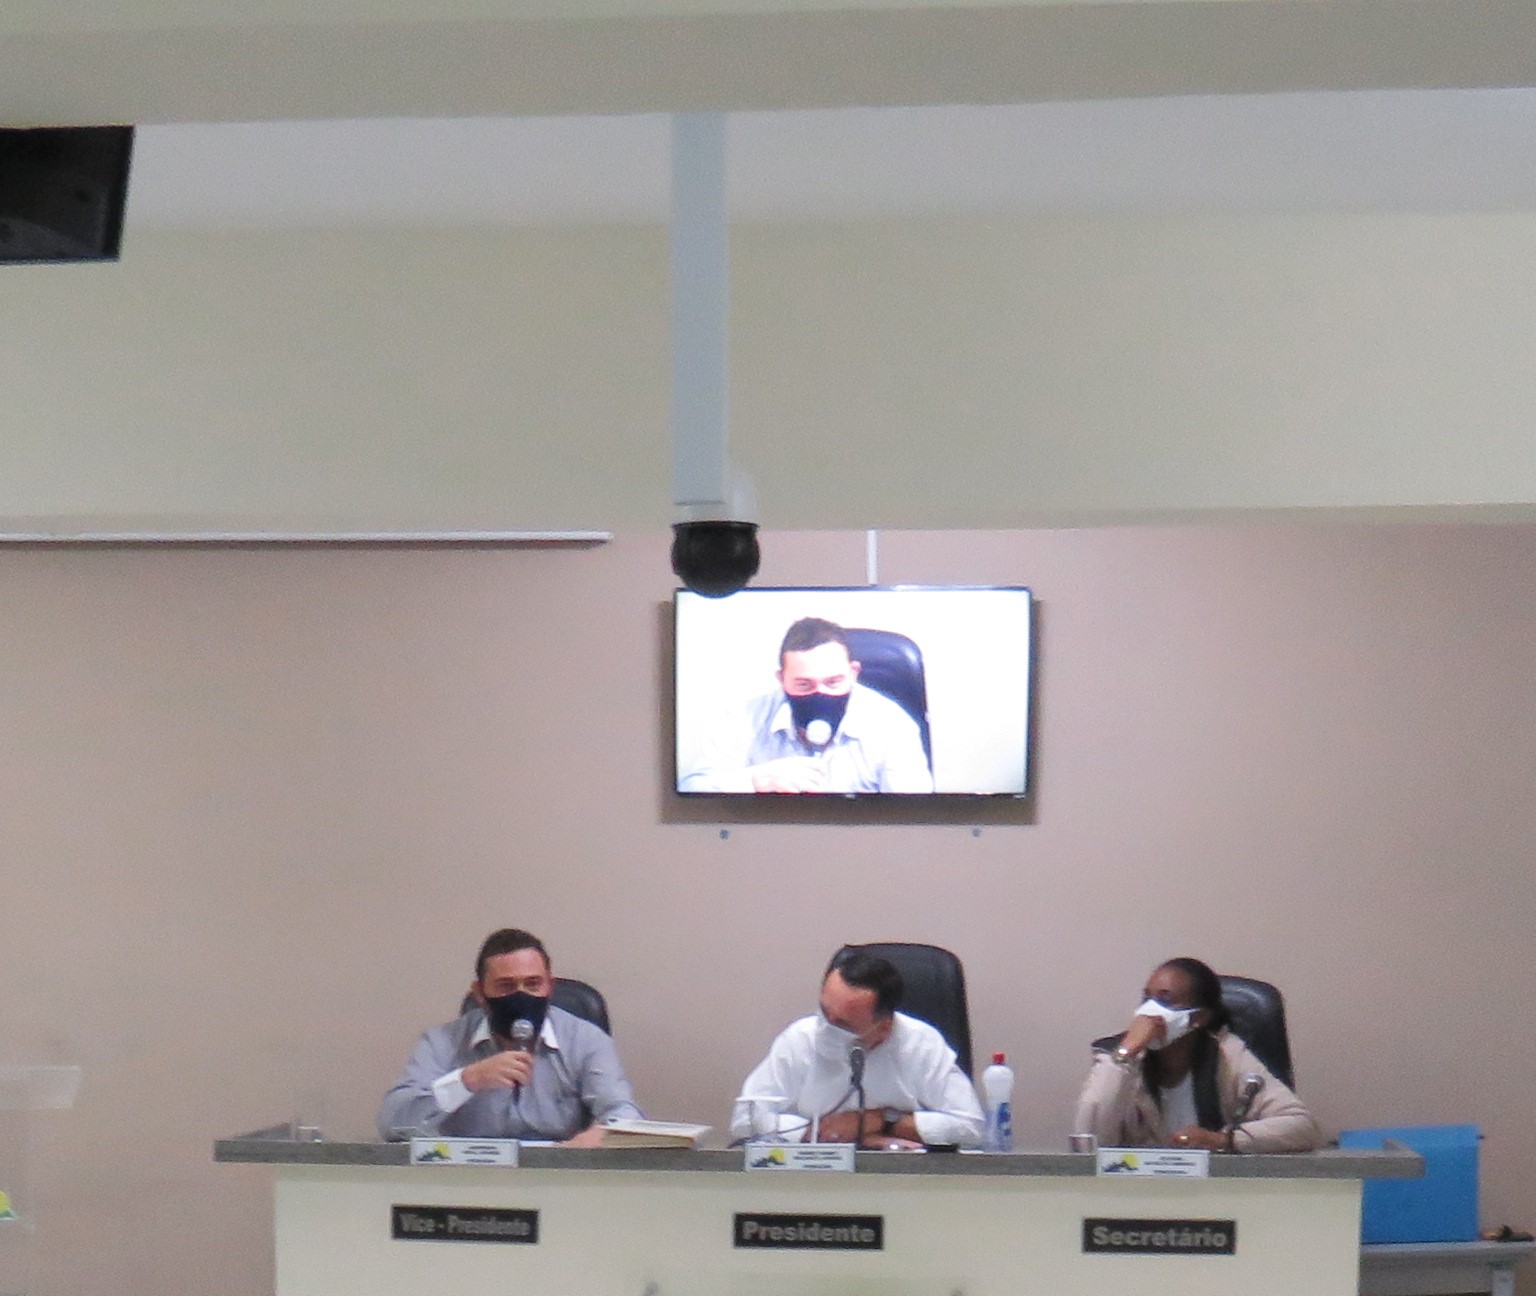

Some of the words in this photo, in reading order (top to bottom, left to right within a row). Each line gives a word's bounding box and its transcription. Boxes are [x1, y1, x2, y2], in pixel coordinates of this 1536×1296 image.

[399, 1213, 435, 1232] Vice
[448, 1214, 531, 1236] Presidente
[742, 1221, 876, 1242] Presidente
[1092, 1226, 1227, 1247] Secretário
